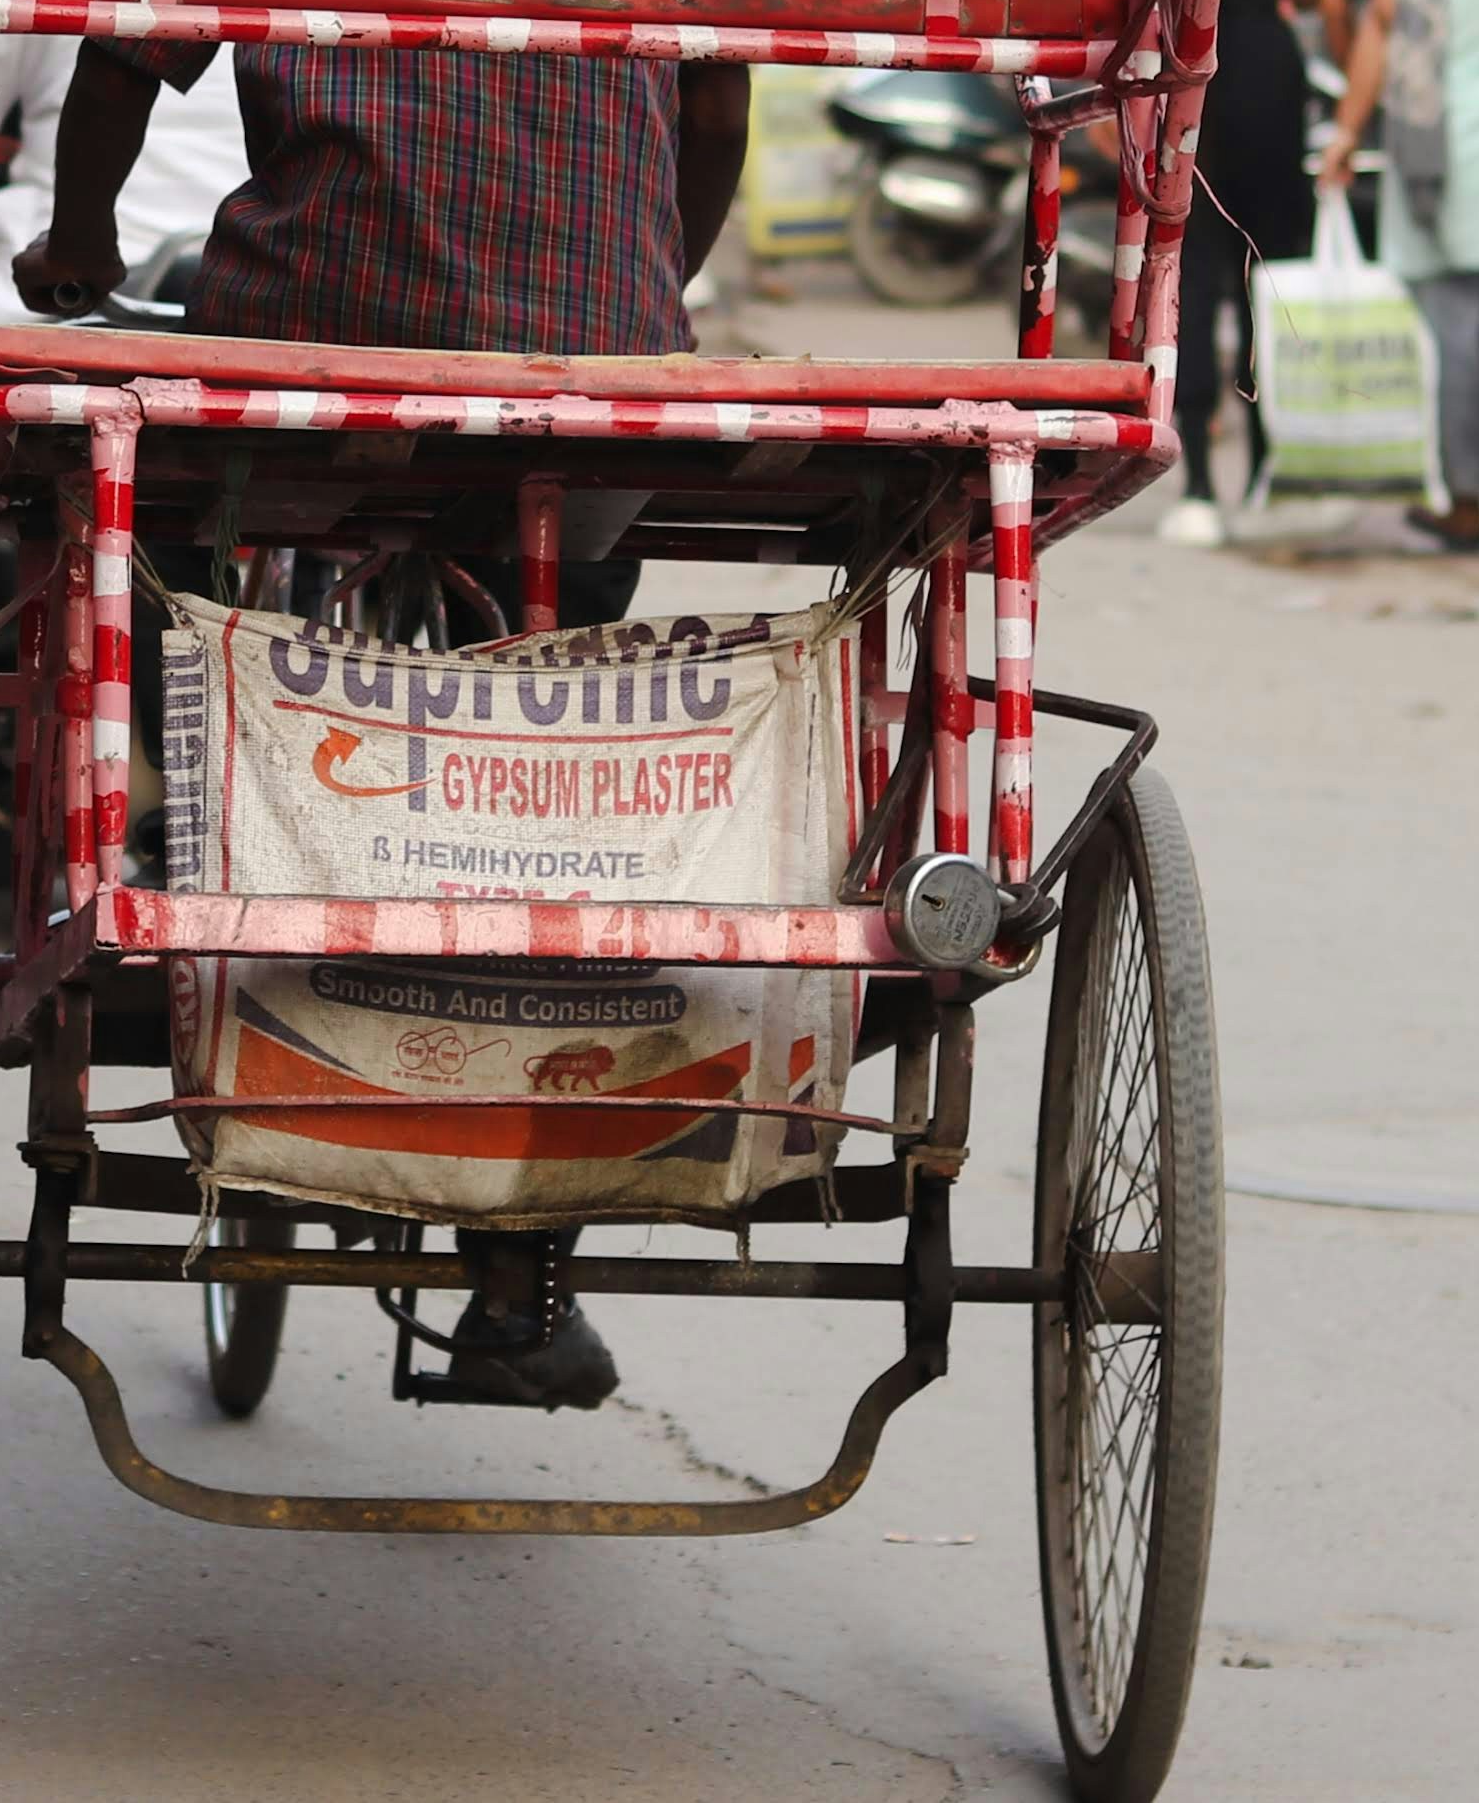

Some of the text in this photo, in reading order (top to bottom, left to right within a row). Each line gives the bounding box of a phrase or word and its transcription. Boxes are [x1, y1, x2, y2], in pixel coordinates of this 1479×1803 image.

[442, 752, 736, 819] GYPSUM PLASTER
[403, 838, 646, 880] HEMIHYDRATE
[320, 967, 682, 1022] Smooth And Consistent
